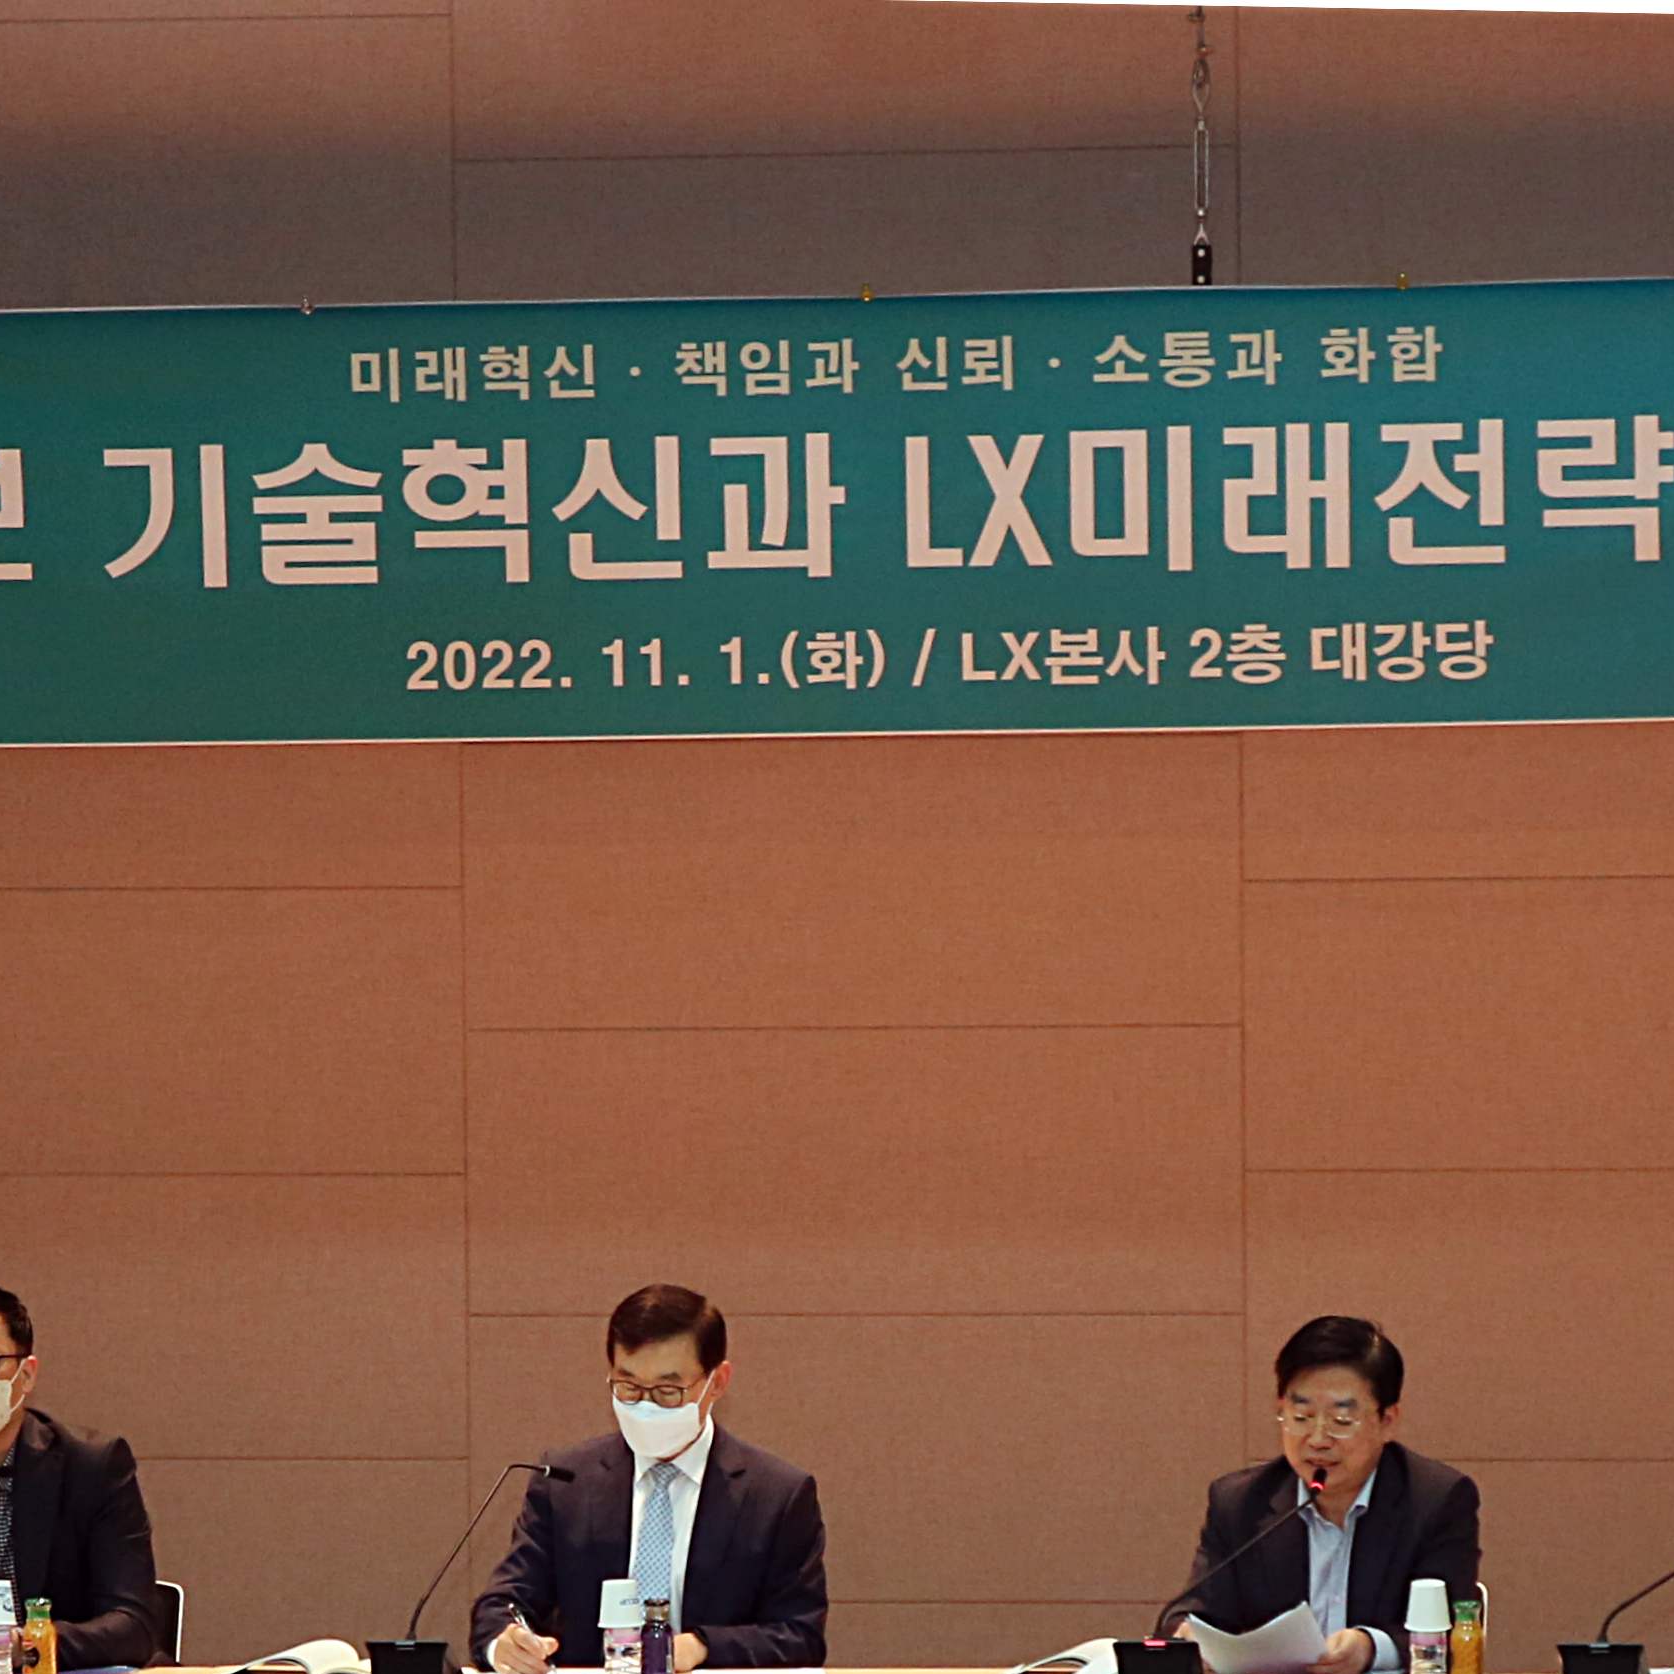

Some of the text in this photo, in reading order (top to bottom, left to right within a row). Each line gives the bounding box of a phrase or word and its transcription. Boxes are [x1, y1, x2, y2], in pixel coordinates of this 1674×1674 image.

[350, 343, 596, 403] 미래혁신
[674, 338, 860, 397] 책임과
[896, 335, 1014, 391] 신뢰
[1092, 329, 1283, 388] 소통과
[1320, 325, 1444, 384] 화합
[102, 432, 847, 588] 기술혁신과
[406, 639, 572, 691] 2022.
[601, 638, 690, 687] 11.
[719, 629, 886, 690] 1.(화)
[961, 626, 1167, 685] LX본사
[1189, 623, 1287, 684] 2층
[1310, 619, 1494, 682] 대강당
